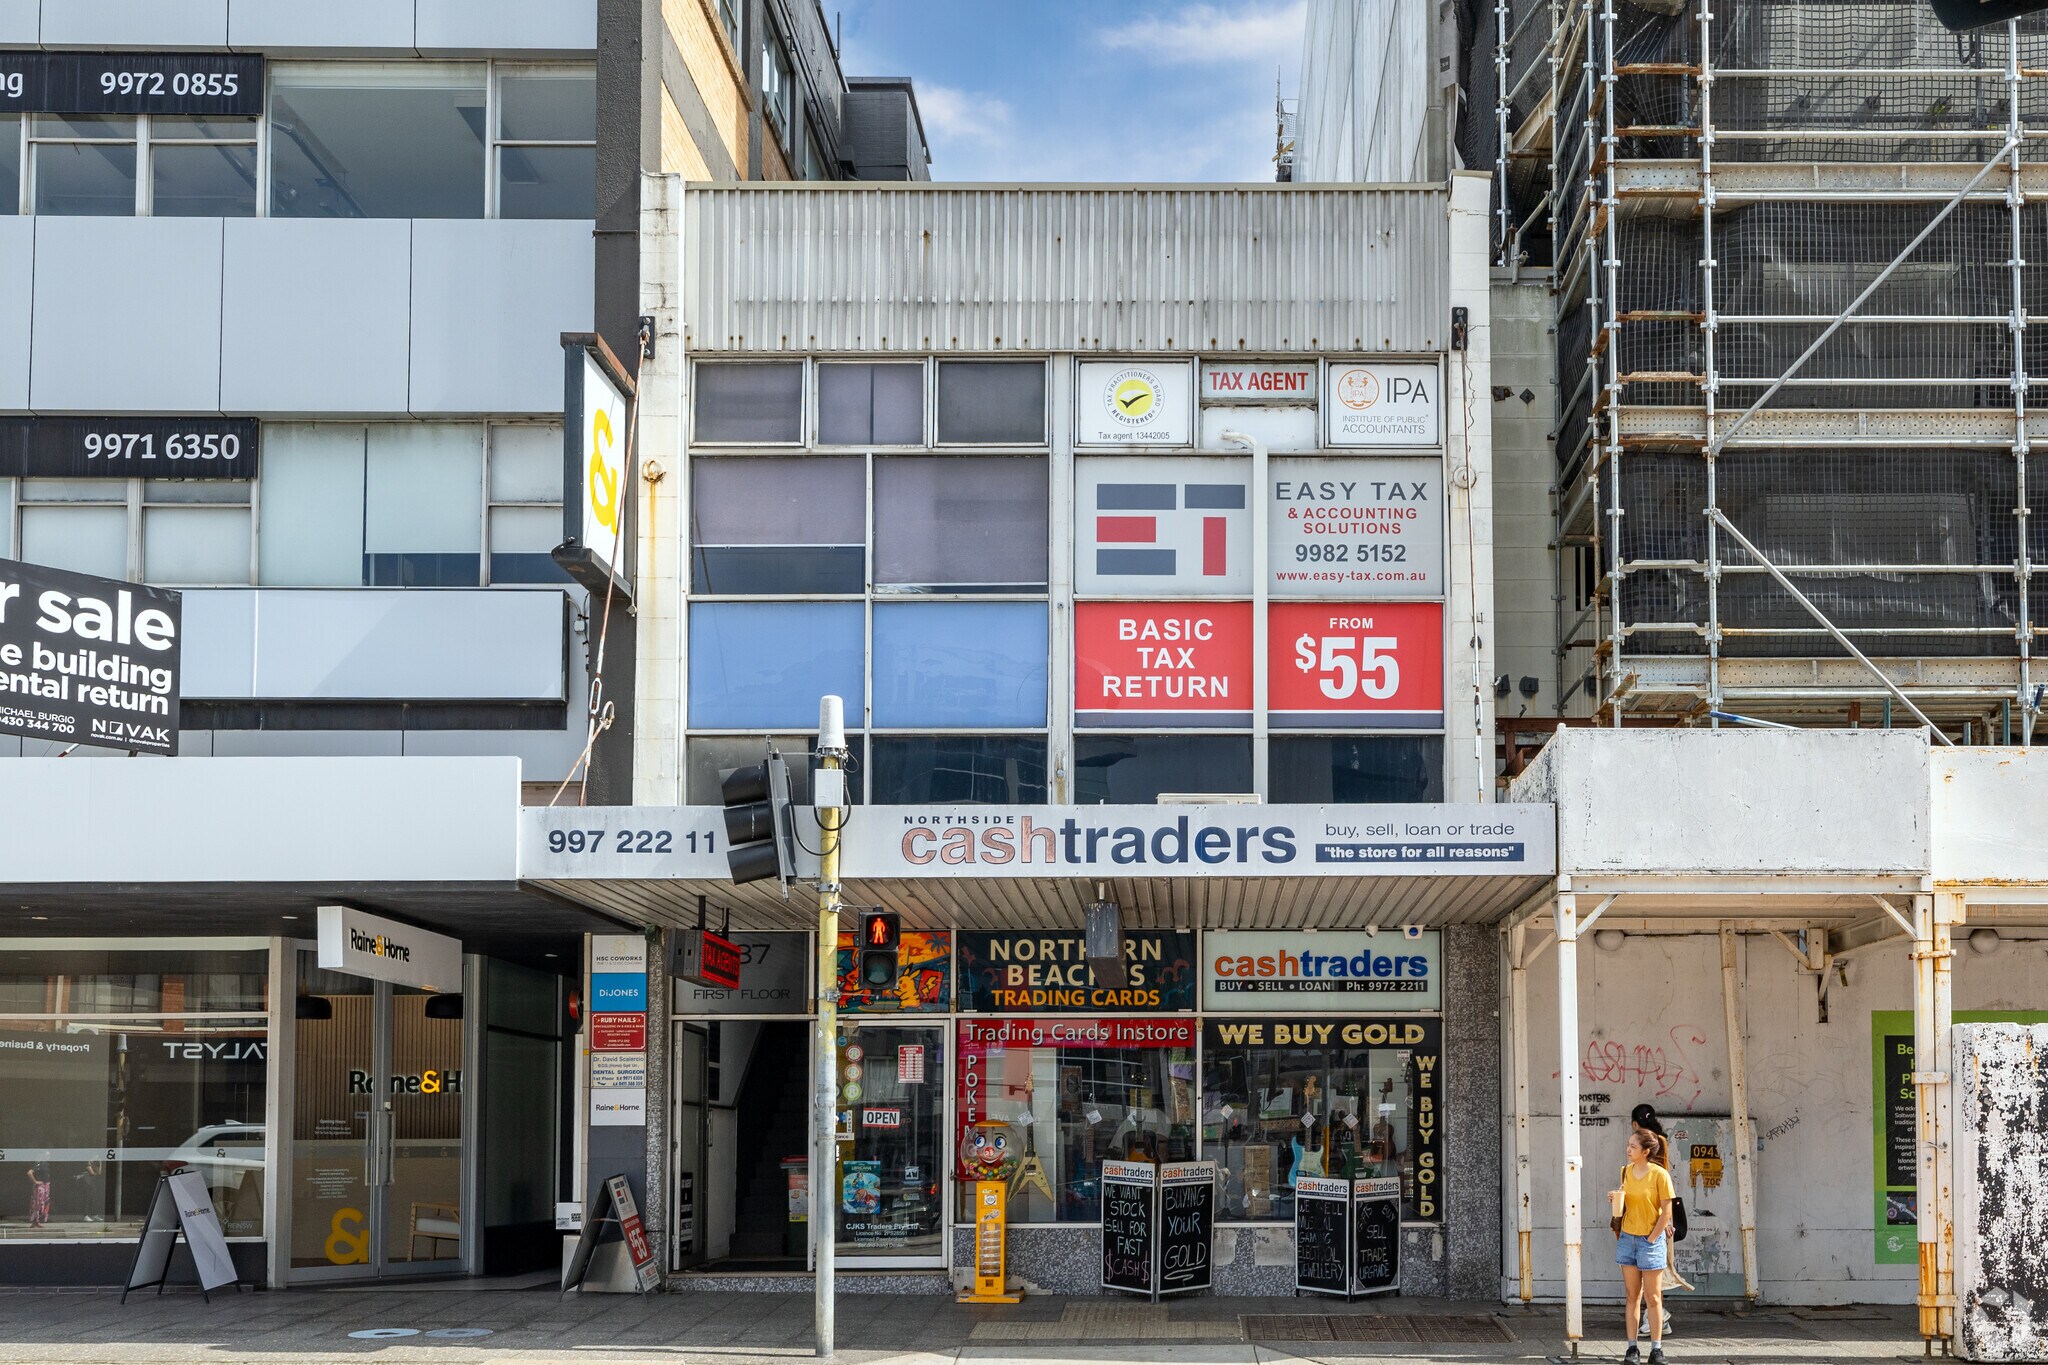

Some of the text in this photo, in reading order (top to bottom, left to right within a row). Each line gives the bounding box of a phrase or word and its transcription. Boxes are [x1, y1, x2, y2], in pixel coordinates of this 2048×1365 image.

[101, 73, 238, 96] 9972 0855
[1110, 372, 1154, 392] PRACTITIONERS
[1209, 372, 1308, 390] TAX AGENT
[1387, 378, 1429, 403] IPA
[1343, 415, 1381, 423] INSTITUTE
[1113, 432, 1133, 441] agent
[1342, 424, 1425, 434] ACCOUNTANTS
[84, 433, 240, 460] 9971 6350
[1275, 482, 1428, 501] EASY TAX
[1288, 508, 1417, 519] & ACCOUNTING
[1303, 523, 1401, 534] SOLUTIONS
[1295, 544, 1406, 562] 9982 5152
[1276, 570, 1426, 583] www.easy-tax.com.au
[36, 590, 175, 651] sale
[1329, 618, 1374, 629] FROM
[1119, 619, 1213, 641] BASIC
[1137, 647, 1195, 669] TAX
[1295, 634, 1400, 699] $55
[32, 641, 172, 694] building
[1103, 676, 1229, 698] RETURN
[78, 683, 168, 715] return
[0, 707, 75, 724] ICHAEL BURGIO
[0, 716, 75, 734] 430 344 700
[91, 732, 123, 742] novak.com.au
[904, 815, 1014, 824] NORTHSIDE
[901, 816, 1297, 864] cashtraders
[1325, 823, 1514, 839] buy, sell, loan or trade
[548, 830, 715, 853] 997 222 11
[1324, 845, 1514, 858] "the store for all reasons"
[350, 928, 410, 963] Raine&Horne
[990, 939, 1161, 961] NORTRN
[1215, 950, 1428, 977] cashtraders
[1008, 964, 1145, 987] BEACS
[694, 989, 790, 999] FIRST FLOOR
[1219, 981, 1424, 991] BUY SELL LOAN Ph: 9972 2211
[991, 989, 1160, 1006] TRADING CARDS
[966, 1023, 1044, 1045] Trading
[1051, 1024, 1109, 1041] Cards
[1117, 1024, 1188, 1041] Instore
[1217, 1024, 1425, 1045] WE BUY GOLD
[1897, 1044, 1915, 1055] Be
[1416, 1056, 1436, 1088] WE
[867, 1111, 897, 1124] OPEN
[1419, 1096, 1434, 1144] BUY
[1104, 1166, 1153, 1178] cashtraders
[1162, 1167, 1213, 1178] cashtraders
[1104, 1184, 1143, 1200] WE WANT
[1297, 1182, 1347, 1193] cashtraders
[1355, 1181, 1399, 1193] cashtraders
[1418, 1152, 1435, 1217] GOLD
[1110, 1201, 1146, 1218] STOCK
[1105, 1218, 1147, 1237] SELL FOR
[1367, 1224, 1387, 1239] SELL
[1117, 1236, 1143, 1256] FAST
[1360, 1246, 1388, 1262] TRADE
[1164, 1242, 1206, 1269] GOLD
